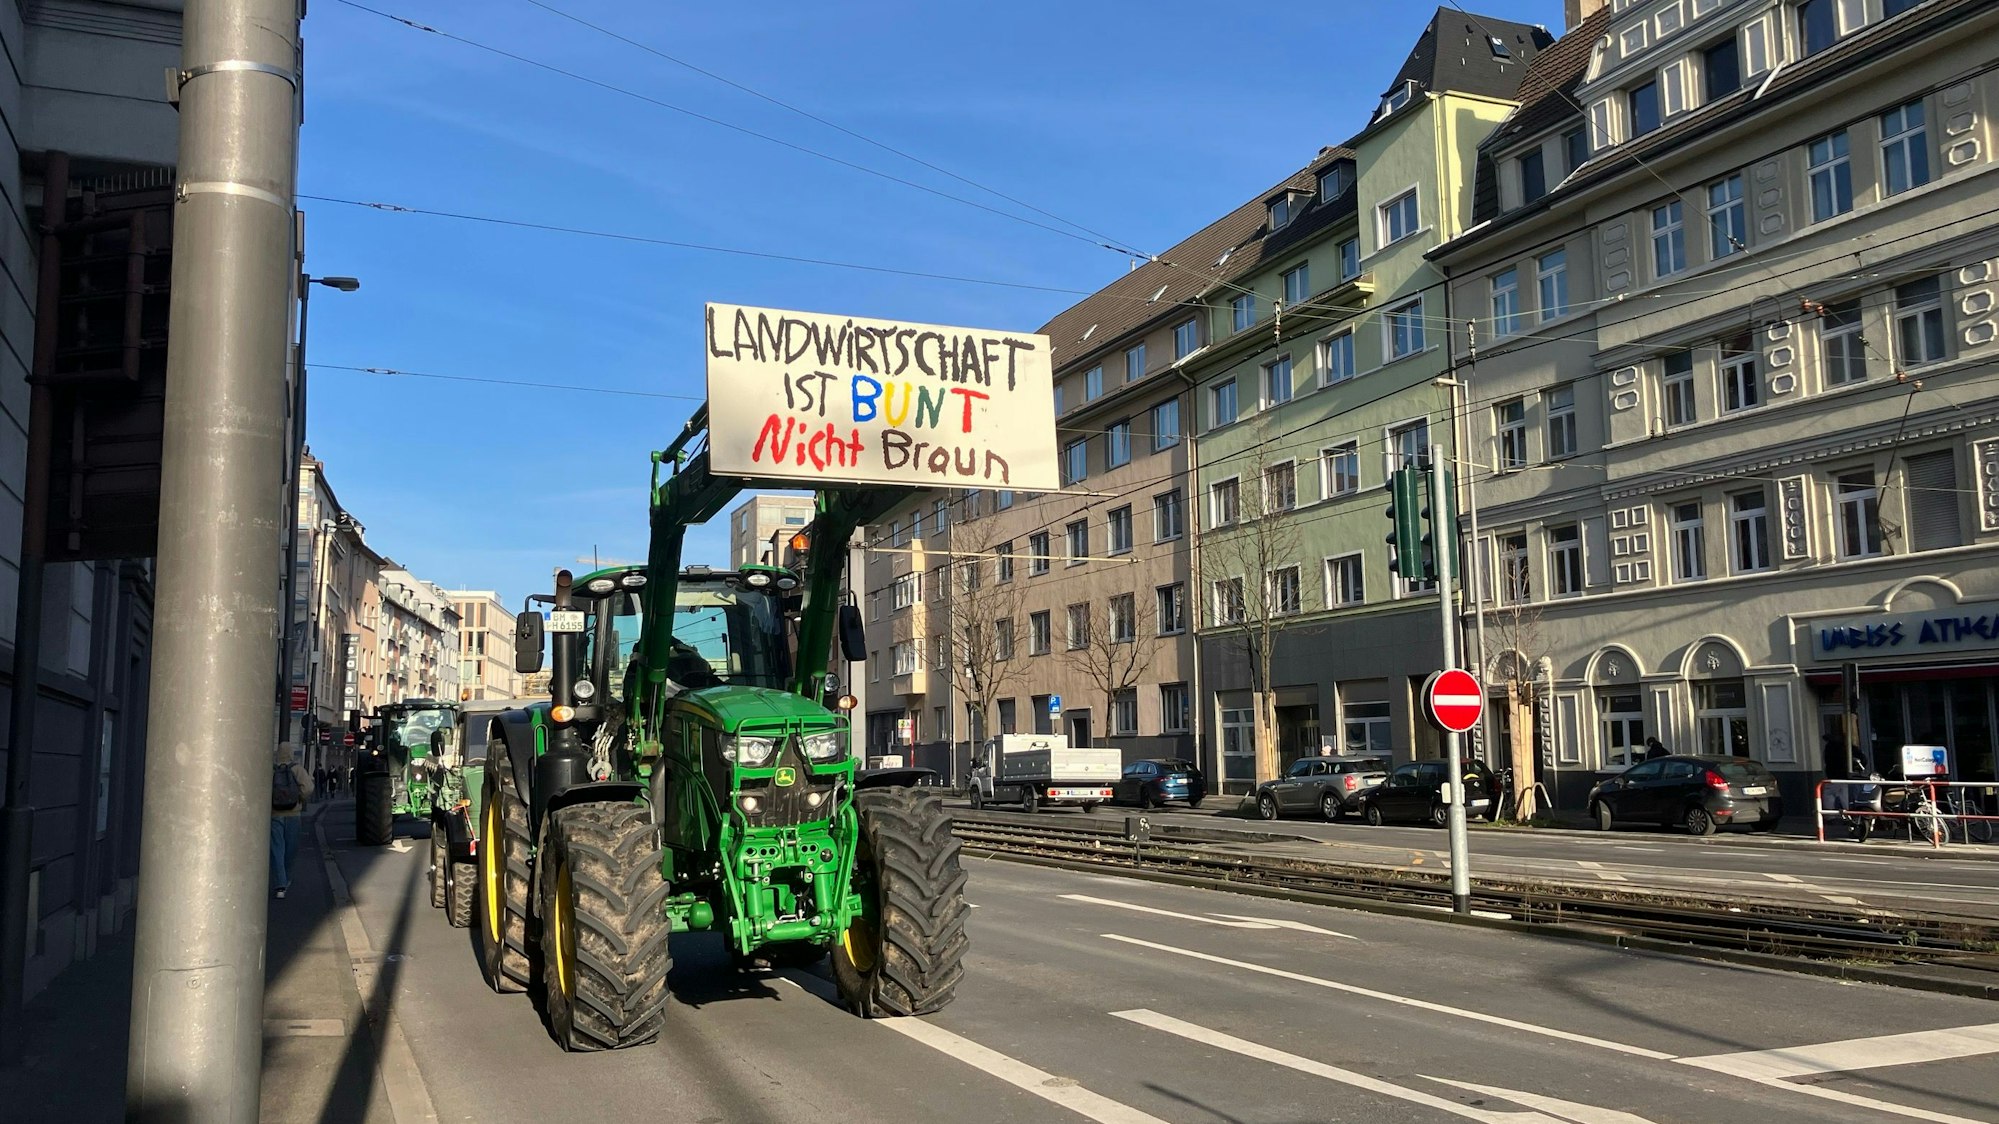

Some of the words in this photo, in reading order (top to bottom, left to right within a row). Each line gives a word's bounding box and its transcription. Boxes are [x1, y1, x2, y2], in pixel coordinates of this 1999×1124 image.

[784, 370, 838, 417] IST
[852, 374, 990, 433] BUNT
[752, 413, 864, 471] Nicht
[881, 428, 1010, 485] Braun
[344, 646, 355, 708] salon
